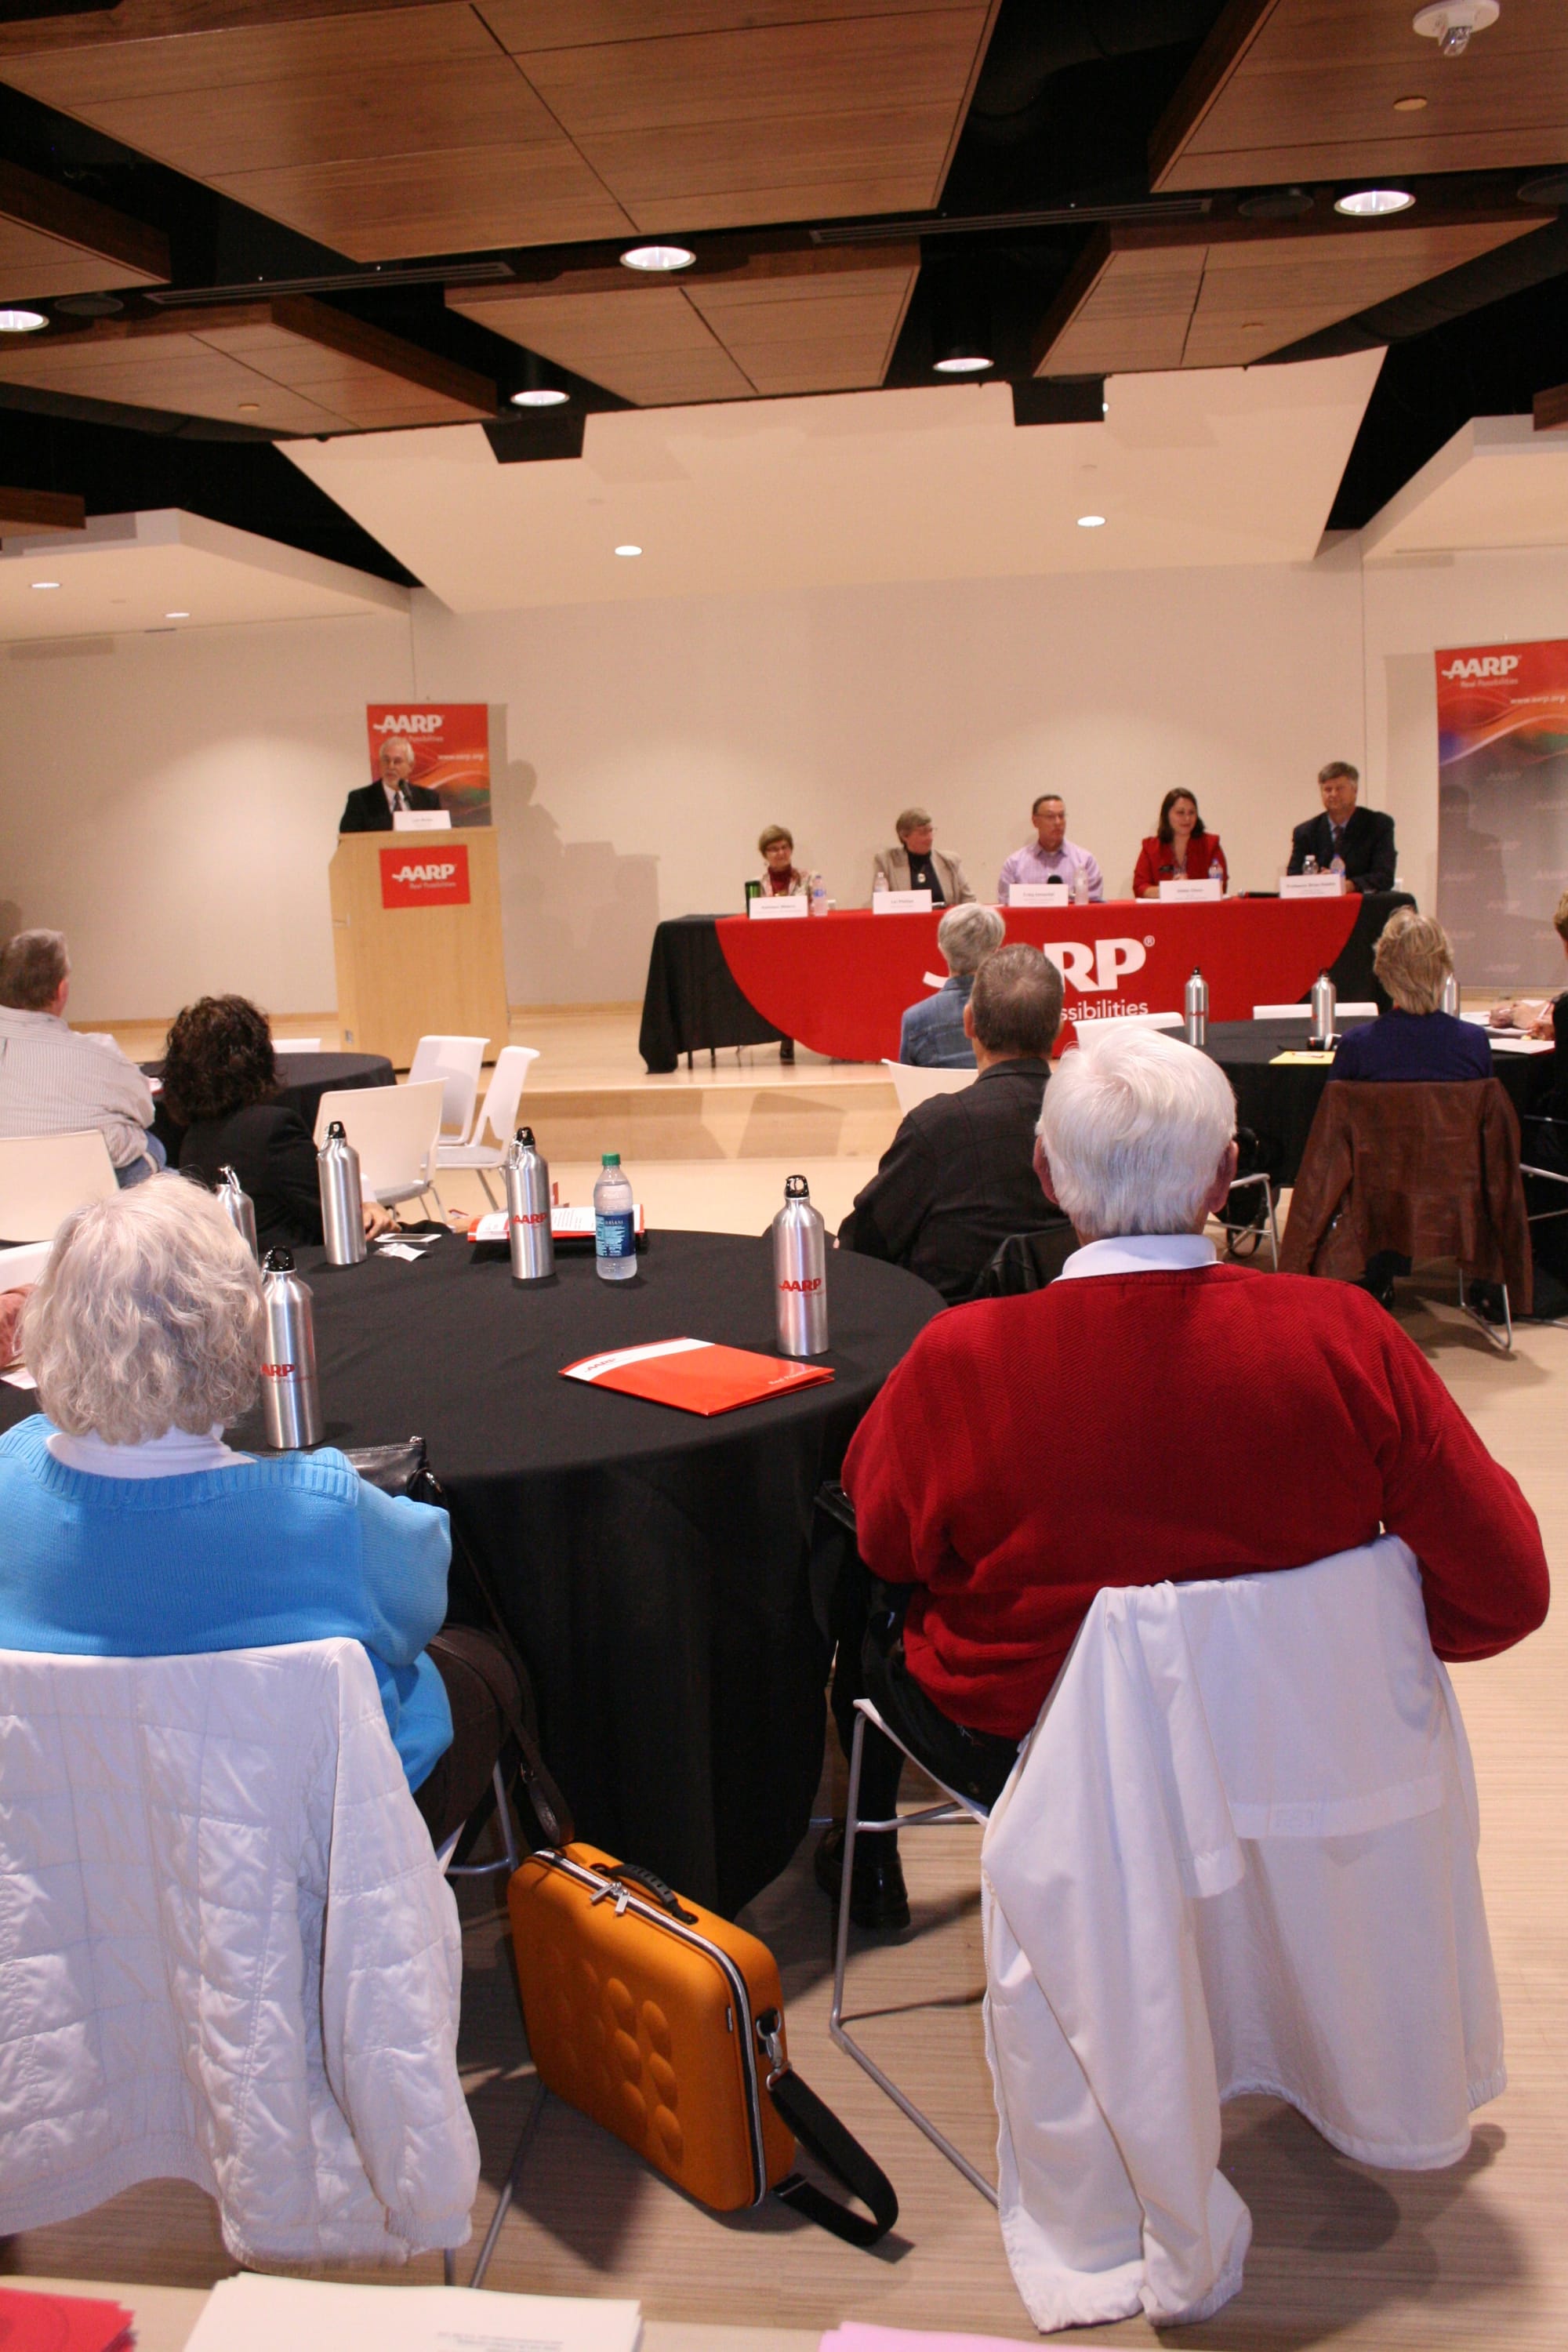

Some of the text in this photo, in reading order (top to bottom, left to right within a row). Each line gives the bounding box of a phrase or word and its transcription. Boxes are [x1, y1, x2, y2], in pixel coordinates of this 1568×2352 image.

[1441, 655, 1519, 679] AARP
[373, 714, 444, 733] AARP
[392, 864, 456, 882] AARP
[1044, 938, 1146, 993] RP
[1061, 999, 1149, 1020] ssibilities
[512, 1213, 547, 1225] AARP
[779, 1278, 822, 1292] AARP
[261, 1363, 295, 1377] ARP
